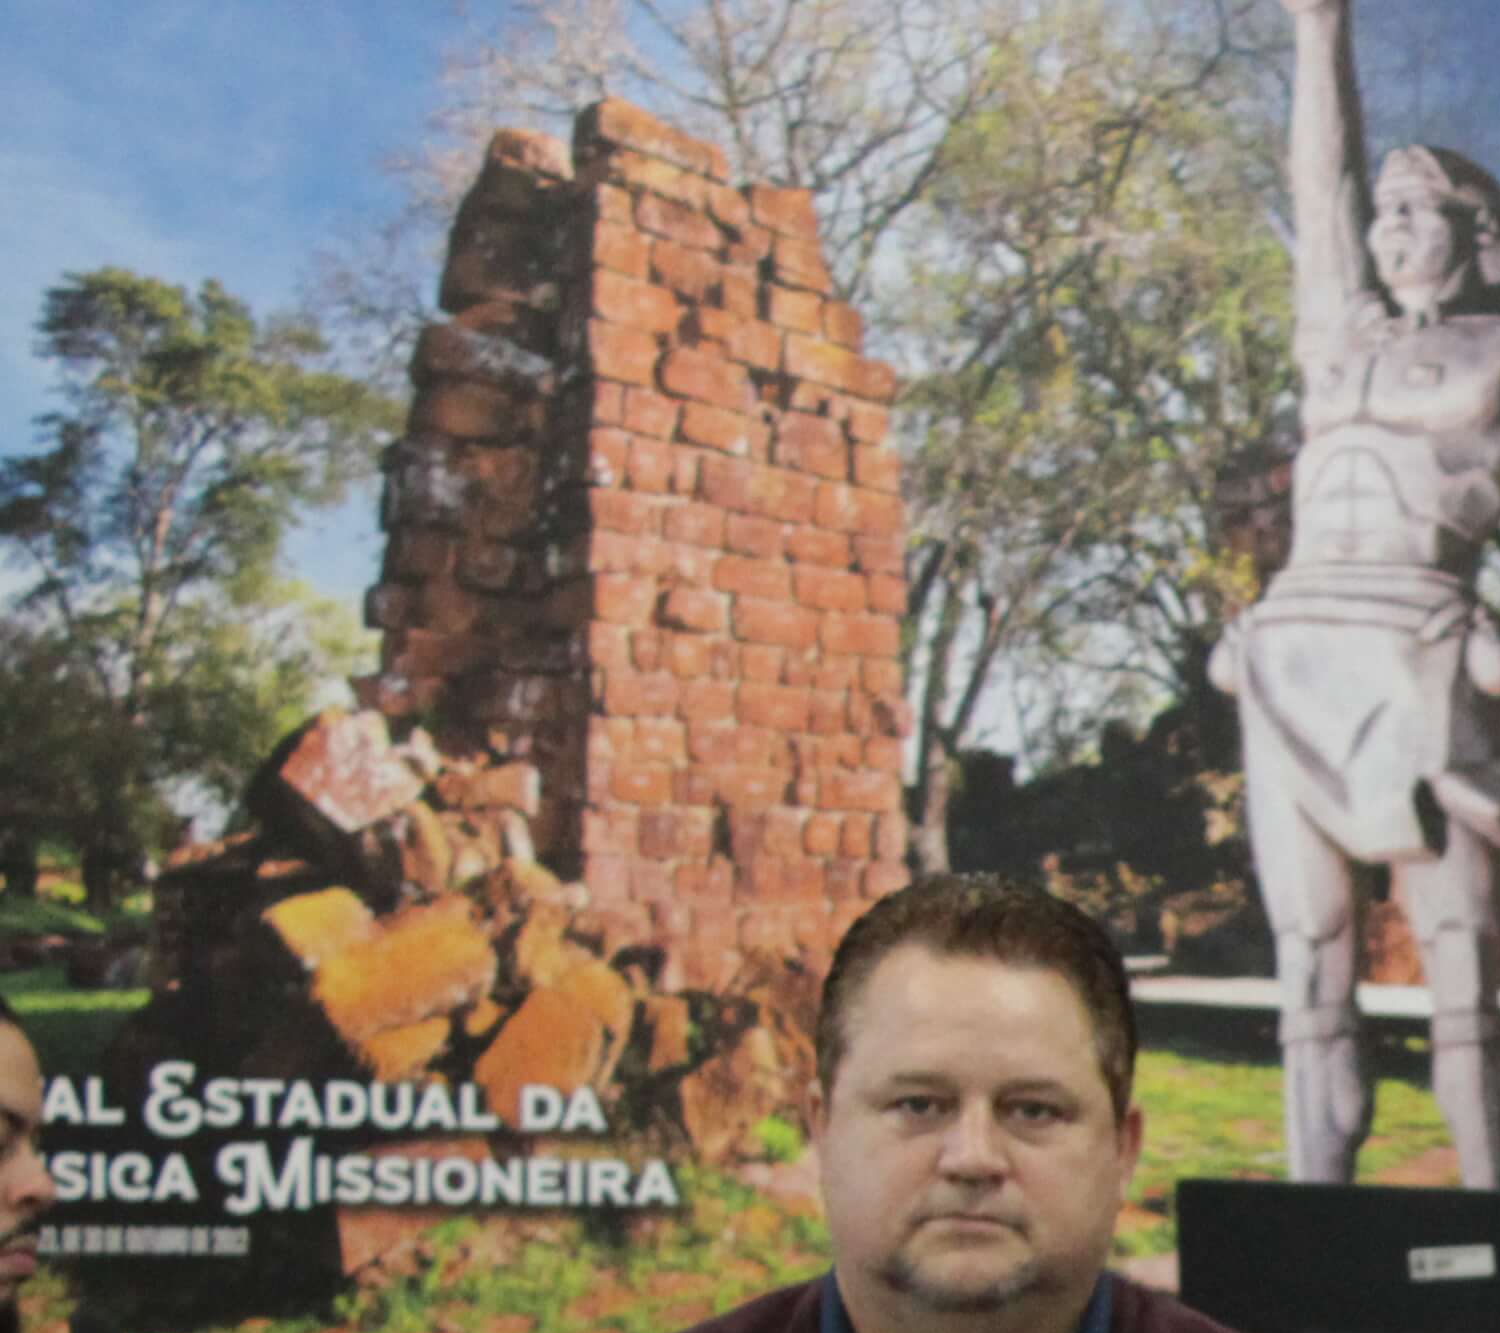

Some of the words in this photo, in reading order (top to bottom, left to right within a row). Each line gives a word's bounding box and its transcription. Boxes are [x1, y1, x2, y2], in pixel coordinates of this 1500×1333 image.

[41, 1075, 125, 1126] AL
[144, 1061, 498, 1138] ESTADUAL
[520, 1085, 607, 1133] DA
[42, 1151, 199, 1203] SICA
[216, 1136, 679, 1215] MISSIONEIRA
